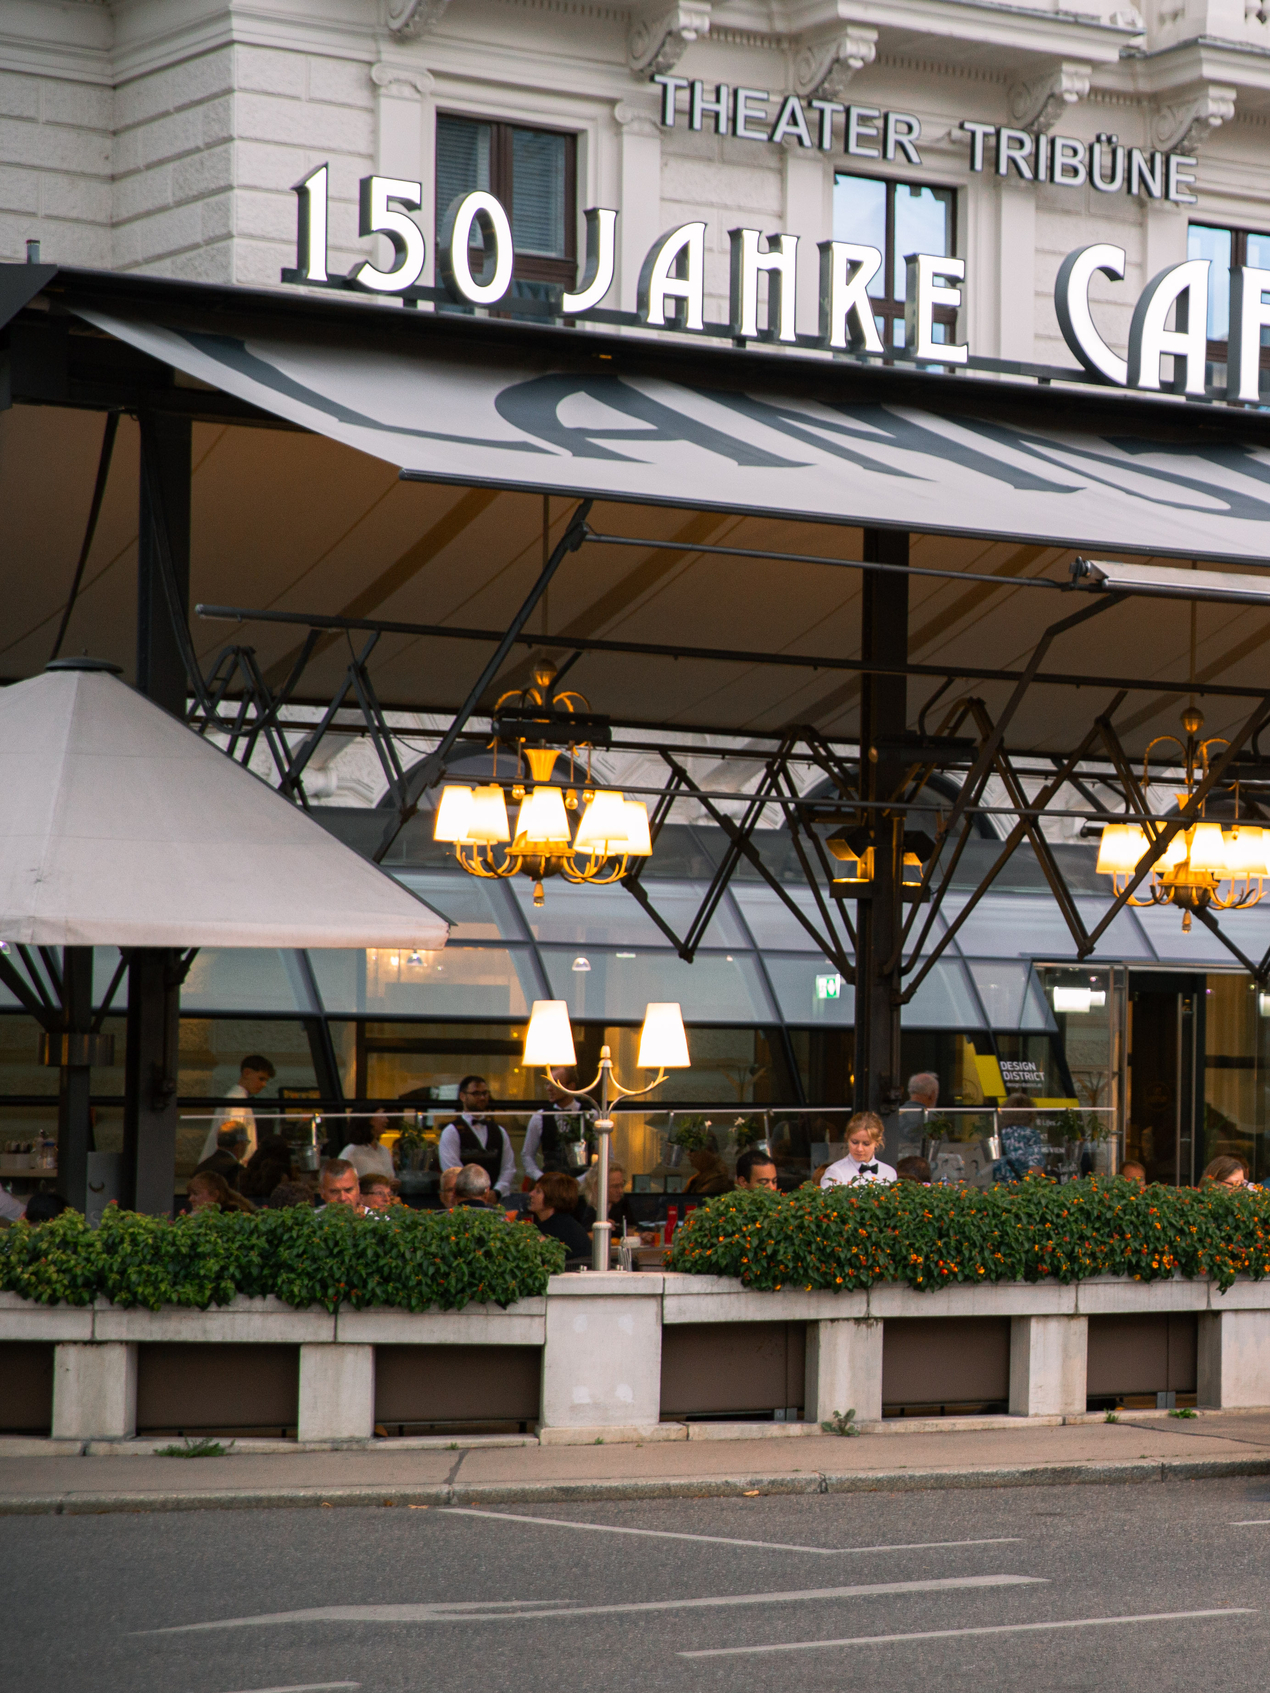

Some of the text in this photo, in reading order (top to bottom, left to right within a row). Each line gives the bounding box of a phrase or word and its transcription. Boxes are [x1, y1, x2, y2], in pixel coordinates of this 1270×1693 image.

[652, 73, 1199, 205] THEATER TRIBÜNE
[289, 161, 514, 307] 150
[562, 207, 969, 364] JAHRE
[1000, 1061, 1037, 1071] DESIGN
[1002, 1071, 1045, 1081] DISTRICT
